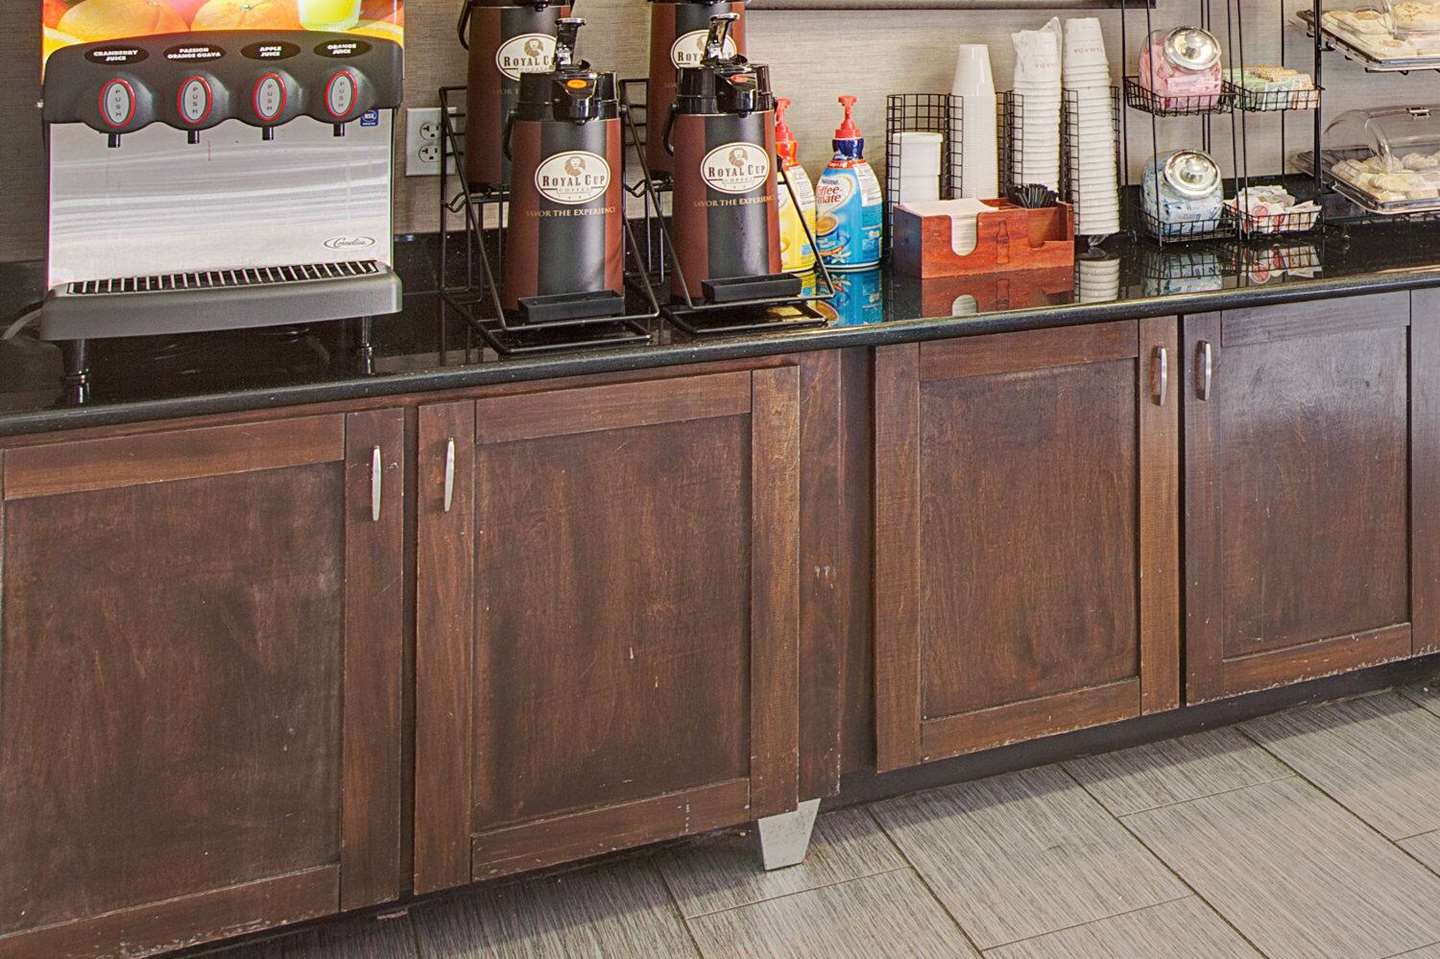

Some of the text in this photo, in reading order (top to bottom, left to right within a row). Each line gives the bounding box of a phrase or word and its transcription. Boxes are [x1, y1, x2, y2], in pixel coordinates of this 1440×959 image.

[503, 56, 541, 67] ROYAL
[677, 51, 705, 62] ROY
[708, 164, 766, 178] ROYAL CUP
[542, 174, 606, 187] ROYAL CUP
[720, 199, 737, 207] THE
[552, 208, 573, 217] THE
[573, 206, 617, 216] EXPERIENC
